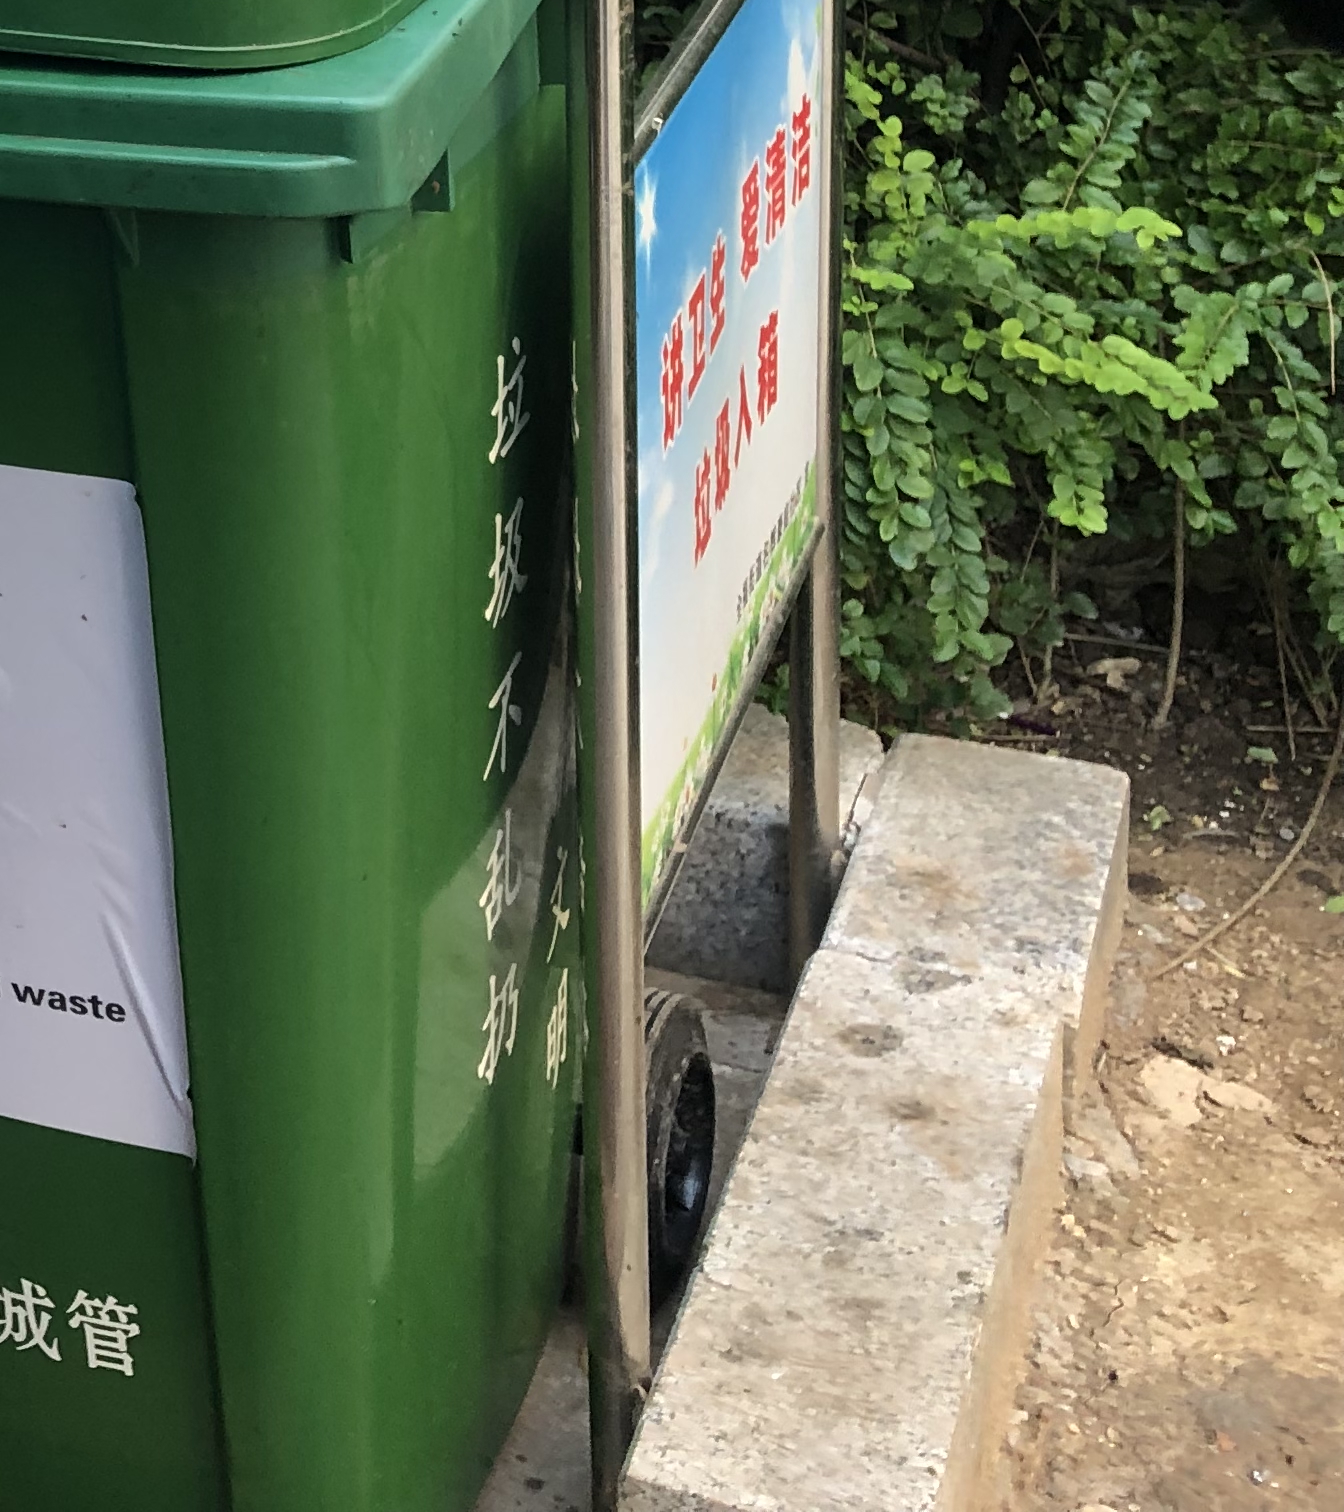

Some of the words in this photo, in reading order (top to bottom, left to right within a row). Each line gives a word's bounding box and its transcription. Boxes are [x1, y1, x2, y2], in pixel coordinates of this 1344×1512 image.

[660, 227, 727, 454] 讲卫生
[739, 92, 812, 282] 爱清洁
[477, 335, 531, 1085] 垃圾不乱扔
[11, 979, 127, 1023] waste
